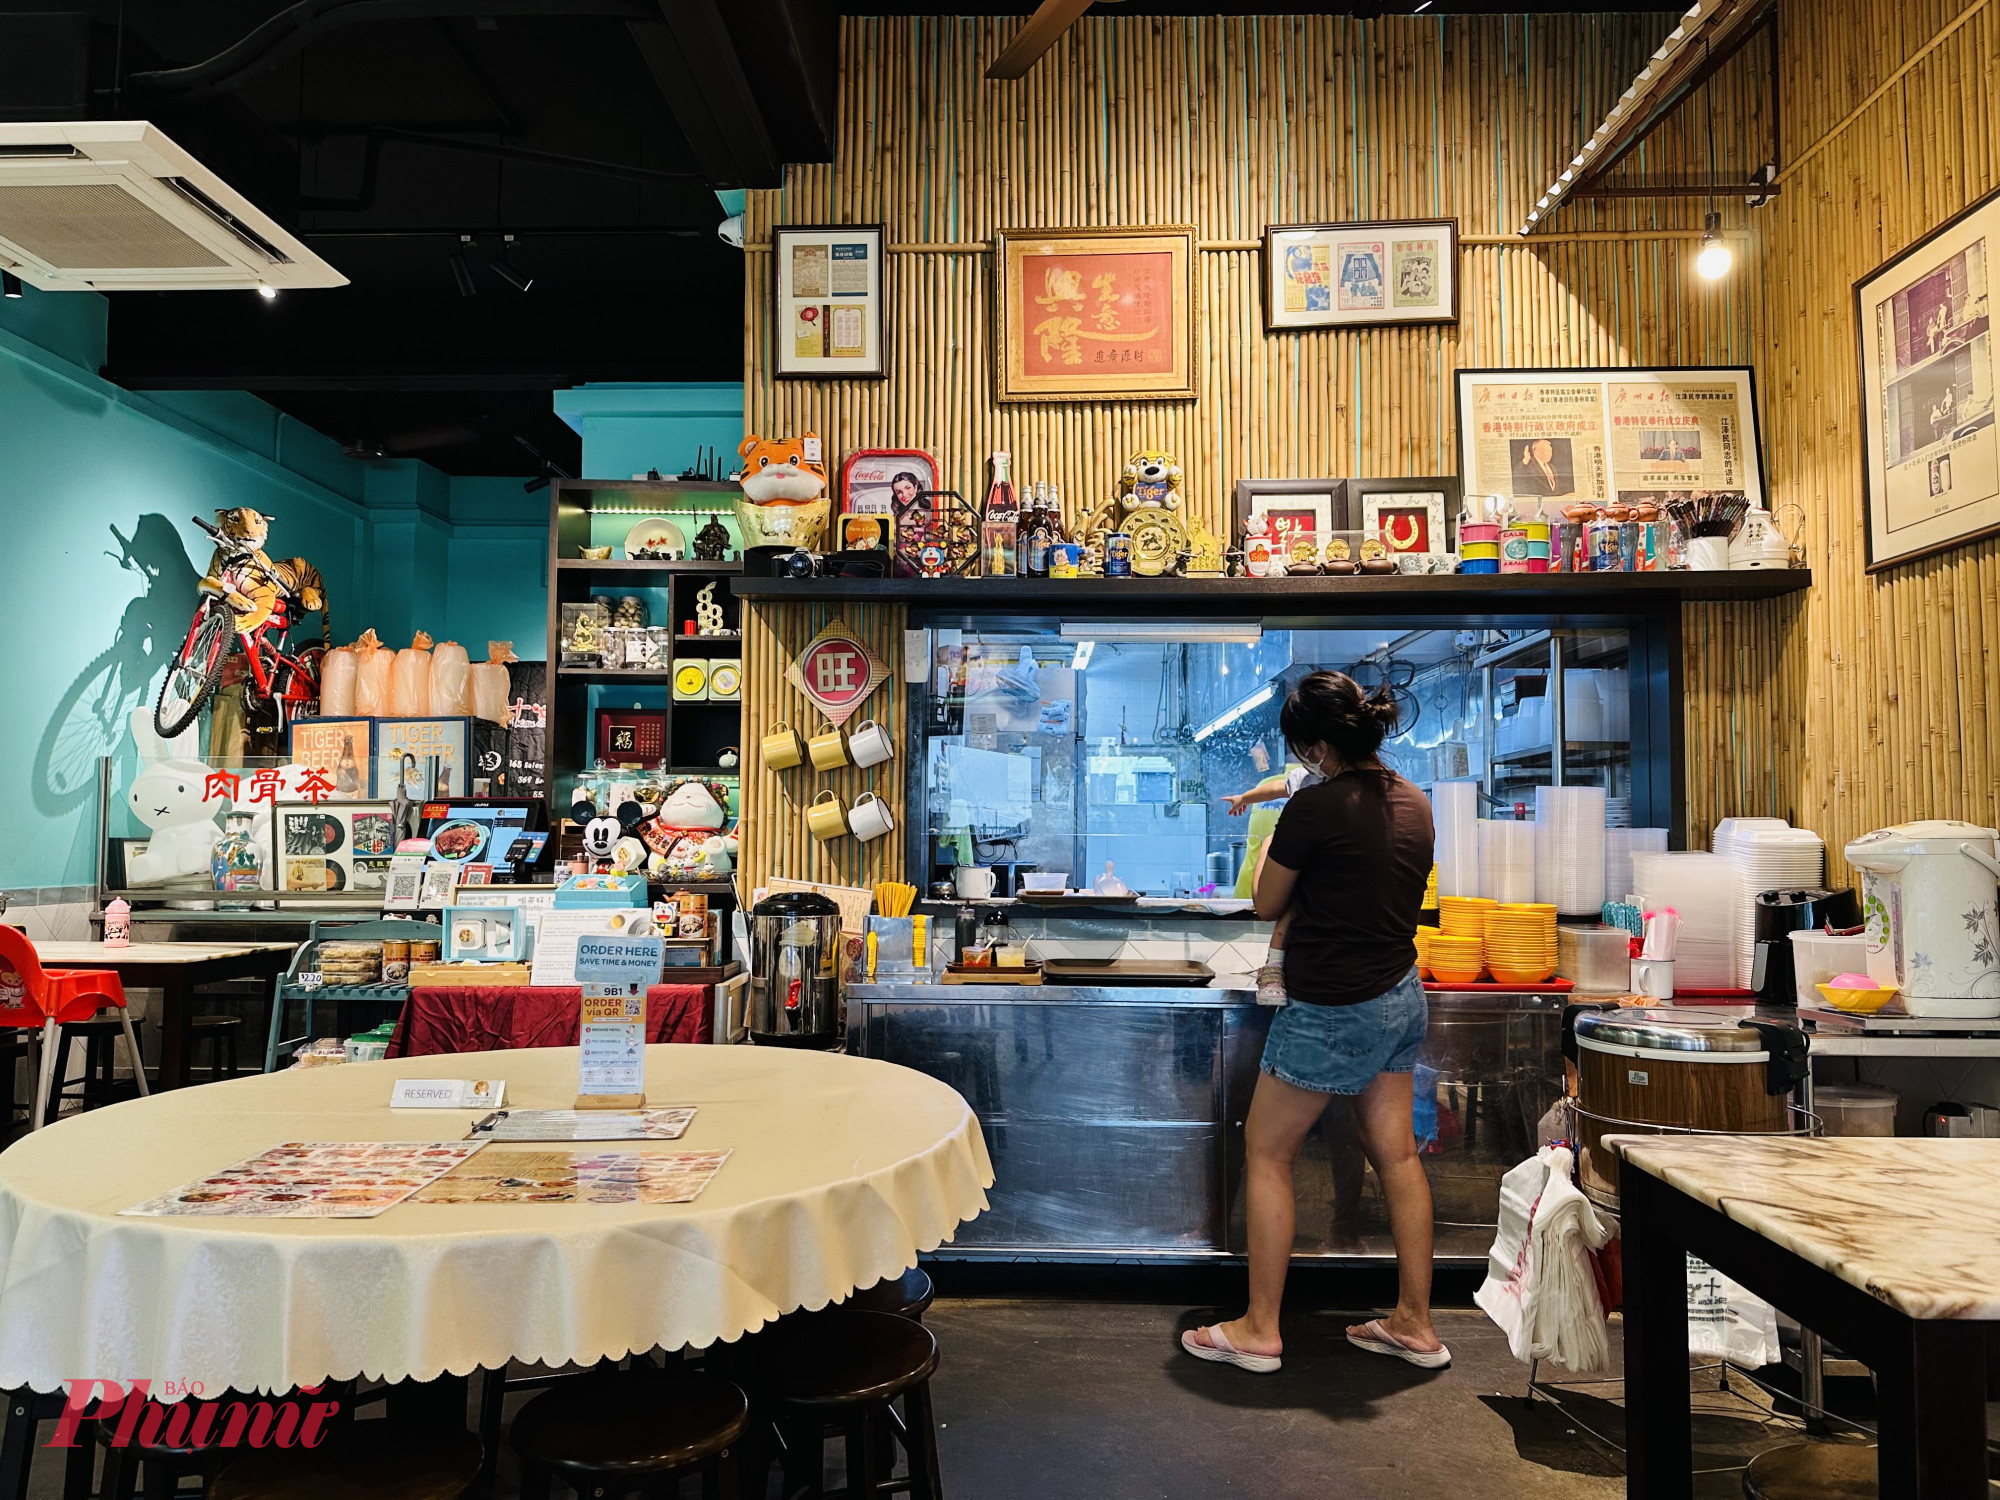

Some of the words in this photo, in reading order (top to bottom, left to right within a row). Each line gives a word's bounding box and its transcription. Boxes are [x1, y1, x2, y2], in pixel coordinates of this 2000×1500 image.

[1482, 421, 1597, 433] 香港特别行政区政府成立
[1136, 484, 1167, 499] Tiger
[1110, 550, 1128, 559] Tiger
[816, 652, 856, 692] 旺
[301, 729, 344, 749] TIGER
[389, 723, 444, 744] TIGER
[302, 750, 342, 768] BEER
[407, 744, 455, 763] BEER
[202, 767, 337, 806] 肉骨茶
[580, 944, 622, 956] ORDER
[625, 946, 658, 957] HERE
[604, 987, 622, 996] 9B1
[584, 998, 622, 1007] ORDER
[586, 1007, 602, 1016] via
[604, 1008, 619, 1016] QR
[404, 1088, 453, 1099] RESERVED
